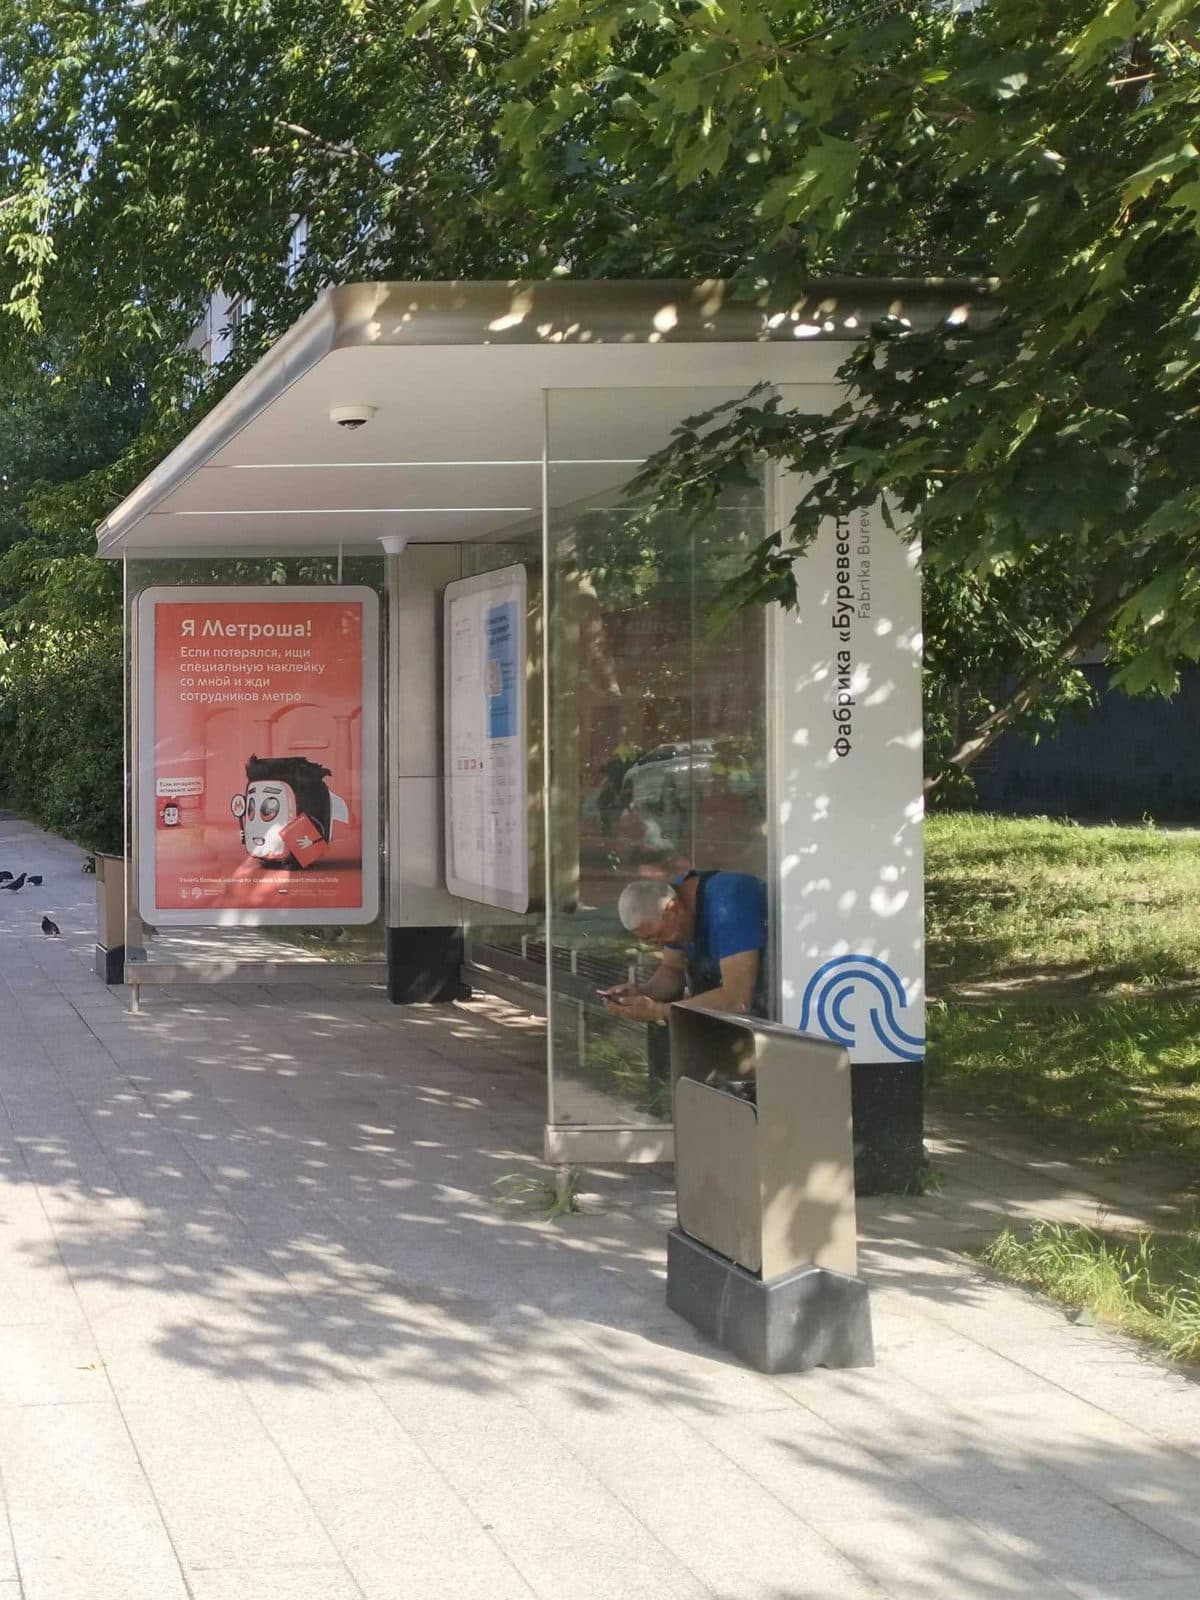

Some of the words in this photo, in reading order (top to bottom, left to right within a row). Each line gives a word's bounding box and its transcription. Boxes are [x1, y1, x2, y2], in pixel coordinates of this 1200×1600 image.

[857, 504, 871, 555] Burev
[832, 513, 855, 642] «Буревест
[857, 560, 871, 619] Fabrika
[180, 619, 195, 637] Я
[201, 619, 312, 640] Метроша!
[180, 646, 210, 658] Если
[213, 647, 282, 660] потерялся,
[284, 648, 311, 659] ищи
[180, 662, 264, 674] специальную
[266, 661, 326, 674] наклейку
[180, 678, 194, 687] со
[197, 676, 231, 687] мной
[234, 678, 242, 687] и
[244, 678, 271, 688] жди
[180, 691, 260, 704] сотрудников
[262, 692, 302, 704] метро
[832, 650, 856, 757] Фабрика
